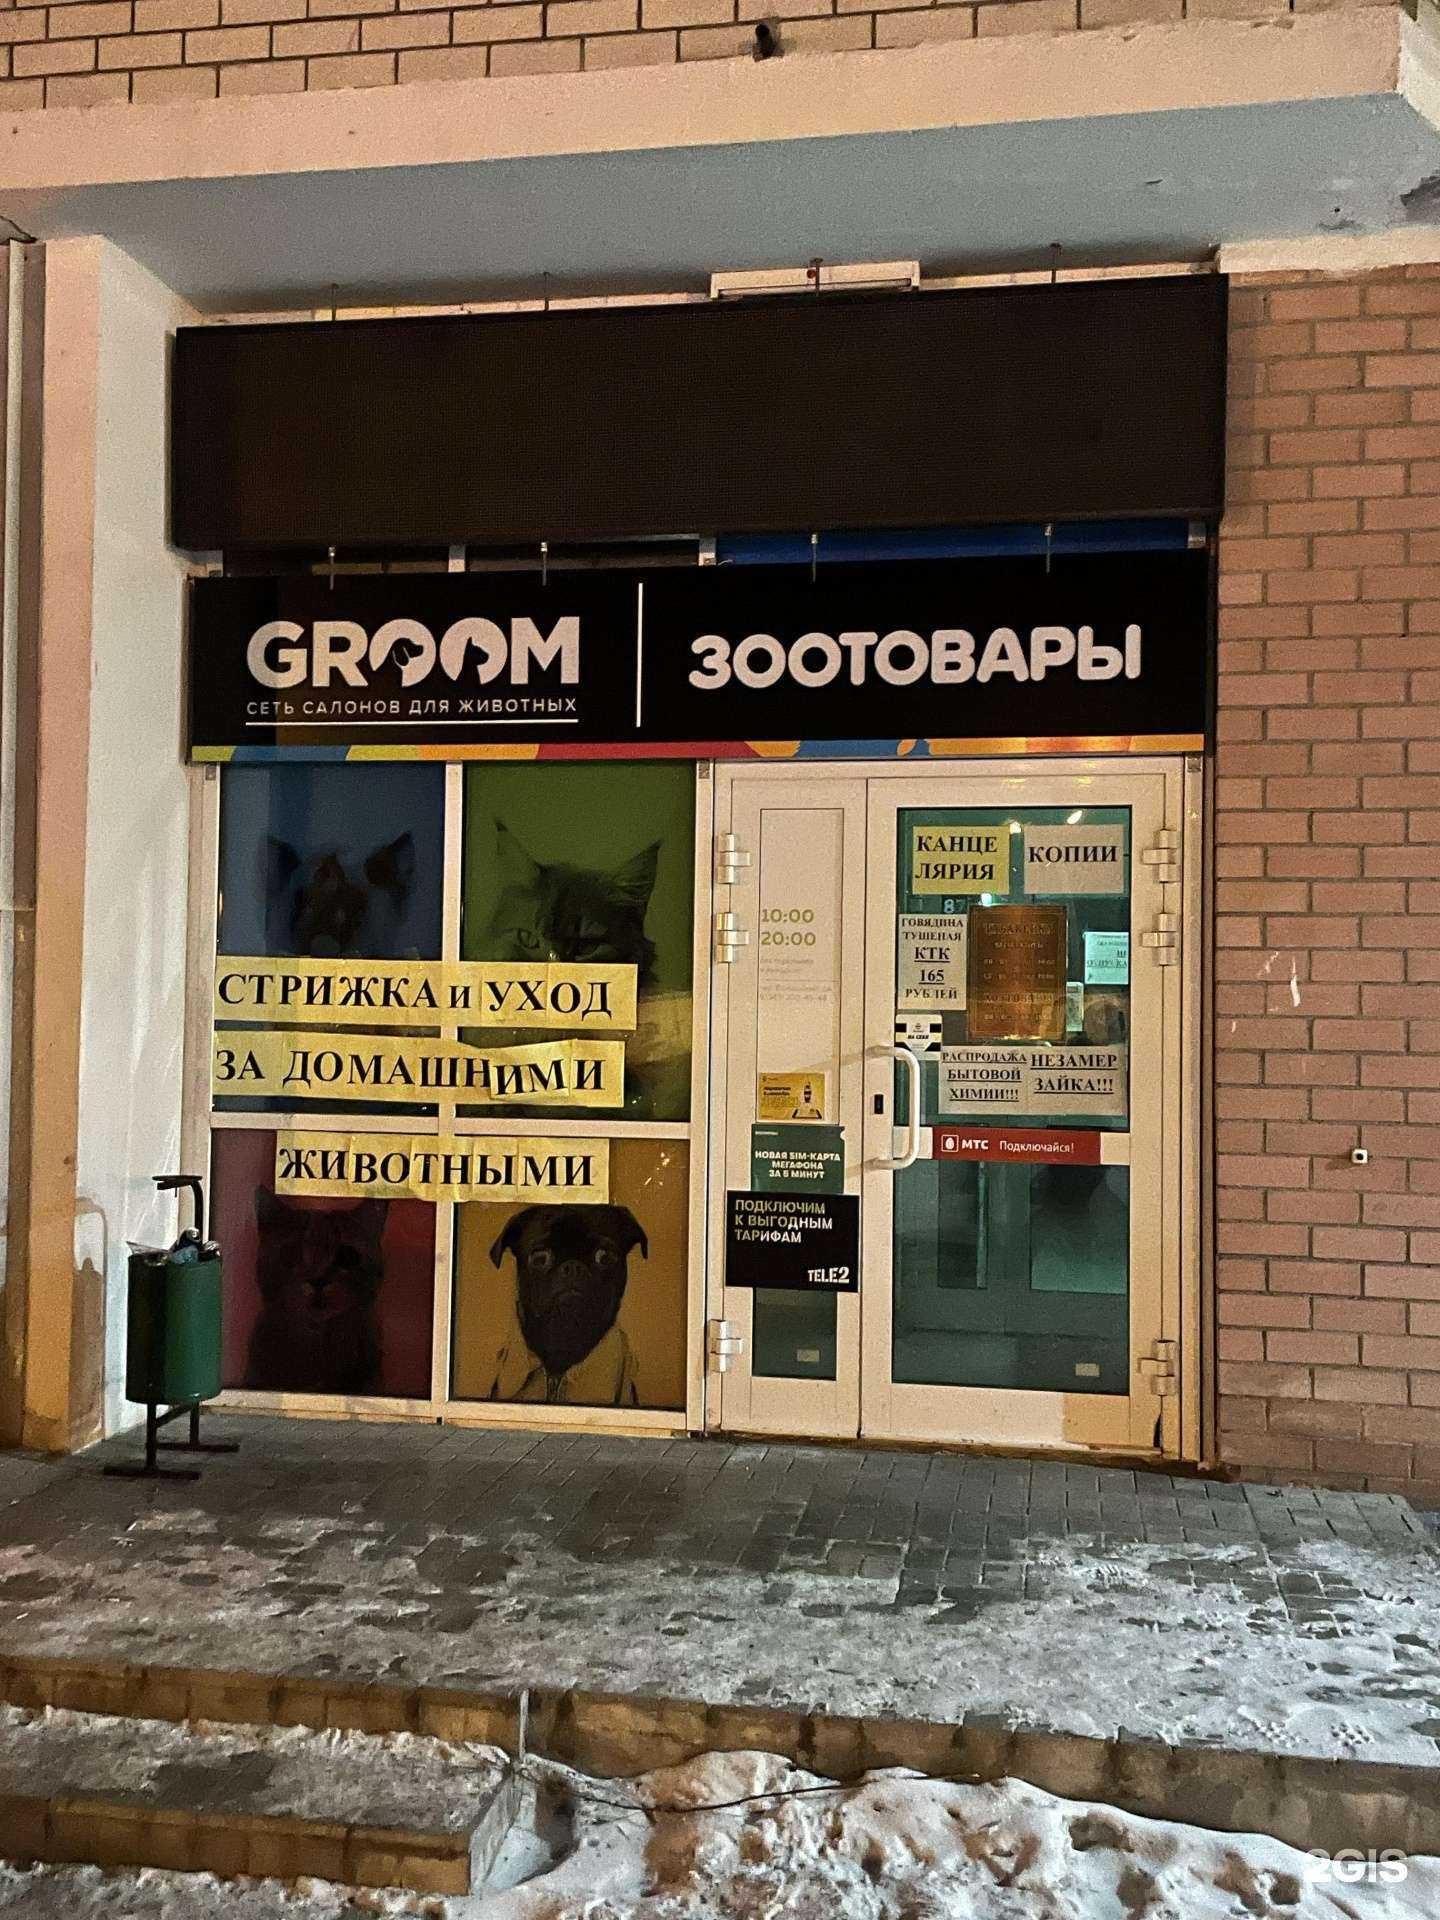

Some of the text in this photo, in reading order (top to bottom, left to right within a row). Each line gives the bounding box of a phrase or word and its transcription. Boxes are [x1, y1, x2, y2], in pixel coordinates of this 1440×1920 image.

[246, 615, 580, 689] GROOM
[688, 623, 1142, 690] ЗООТОВАРЫ
[246, 697, 577, 716] СЕТЬ САЛОНОВ ДЛЯ ЖИВОТНЫХ
[916, 835, 998, 856] КАНЦЕ
[1028, 845, 1118, 864] КОПИИ
[915, 862, 995, 881] ЛЯРИЯ
[761, 908, 814, 923] 10:00
[901, 918, 964, 928] ГОВЯДИНА
[760, 931, 816, 946] 20:00
[914, 947, 950, 961] КТК
[918, 969, 945, 983] 165
[217, 973, 613, 1021] СТРИЖКА и УХОД
[905, 987, 958, 999] РУБЛЕЙ
[942, 1051, 1027, 1064] РАСПРОДАЖА
[1030, 1053, 1118, 1068] НЕЗАМЕР
[215, 1049, 606, 1095] ЗА ДОМАШНИМИ
[947, 1067, 1022, 1081] БЫТОВОЙ
[1034, 1076, 1114, 1093] ЗАЙКА!!!
[949, 1087, 1019, 1101] ХИМИИ!!!
[961, 1139, 1075, 1153] МТС Подключайся!
[755, 1151, 788, 1160] НОВАЯ
[278, 1148, 594, 1187] ЖИВОТНЫМИ
[771, 1160, 824, 1170] МЕГАФОНА
[768, 1169, 781, 1178] ЗА
[790, 1170, 825, 1179] МИНУТ
[735, 1199, 826, 1214] ПОДКЛЮЧИМ
[735, 1214, 833, 1230] К ВЫГОДНЫМ
[735, 1228, 802, 1243] ТАРИФАМ
[808, 1266, 850, 1283] TELE2
